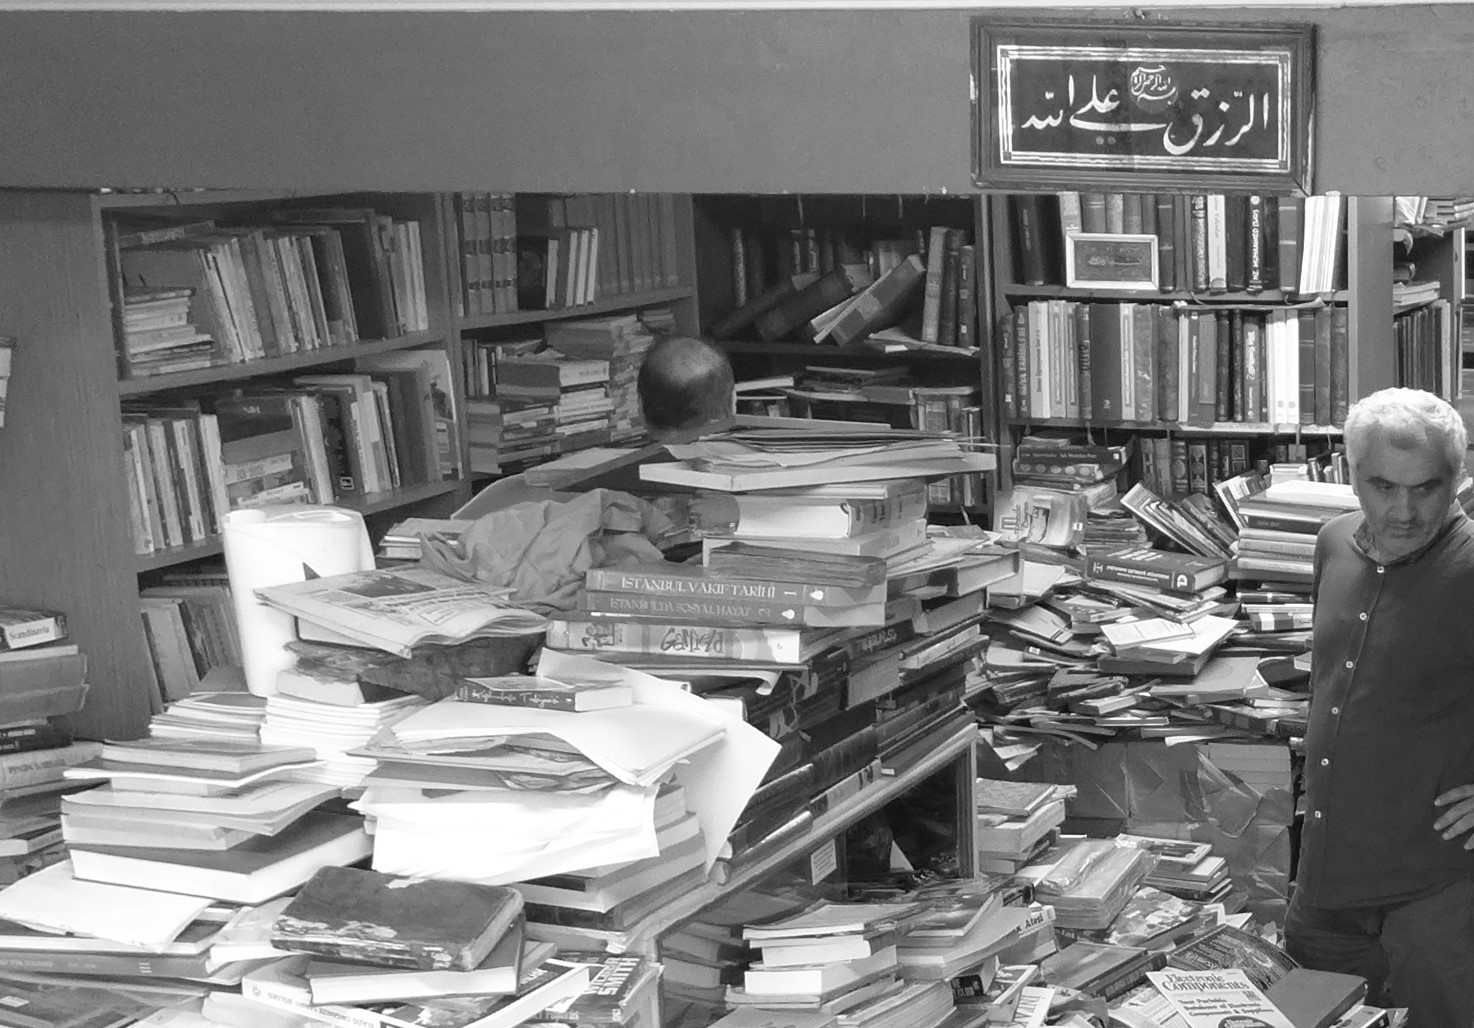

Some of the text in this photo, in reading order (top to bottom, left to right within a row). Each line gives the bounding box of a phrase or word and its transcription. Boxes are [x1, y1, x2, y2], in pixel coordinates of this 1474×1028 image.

[731, 581, 775, 598] TARİHİ
[661, 626, 724, 653] Garfield
[597, 956, 640, 995] SMITH
[1160, 980, 1250, 992] Components
